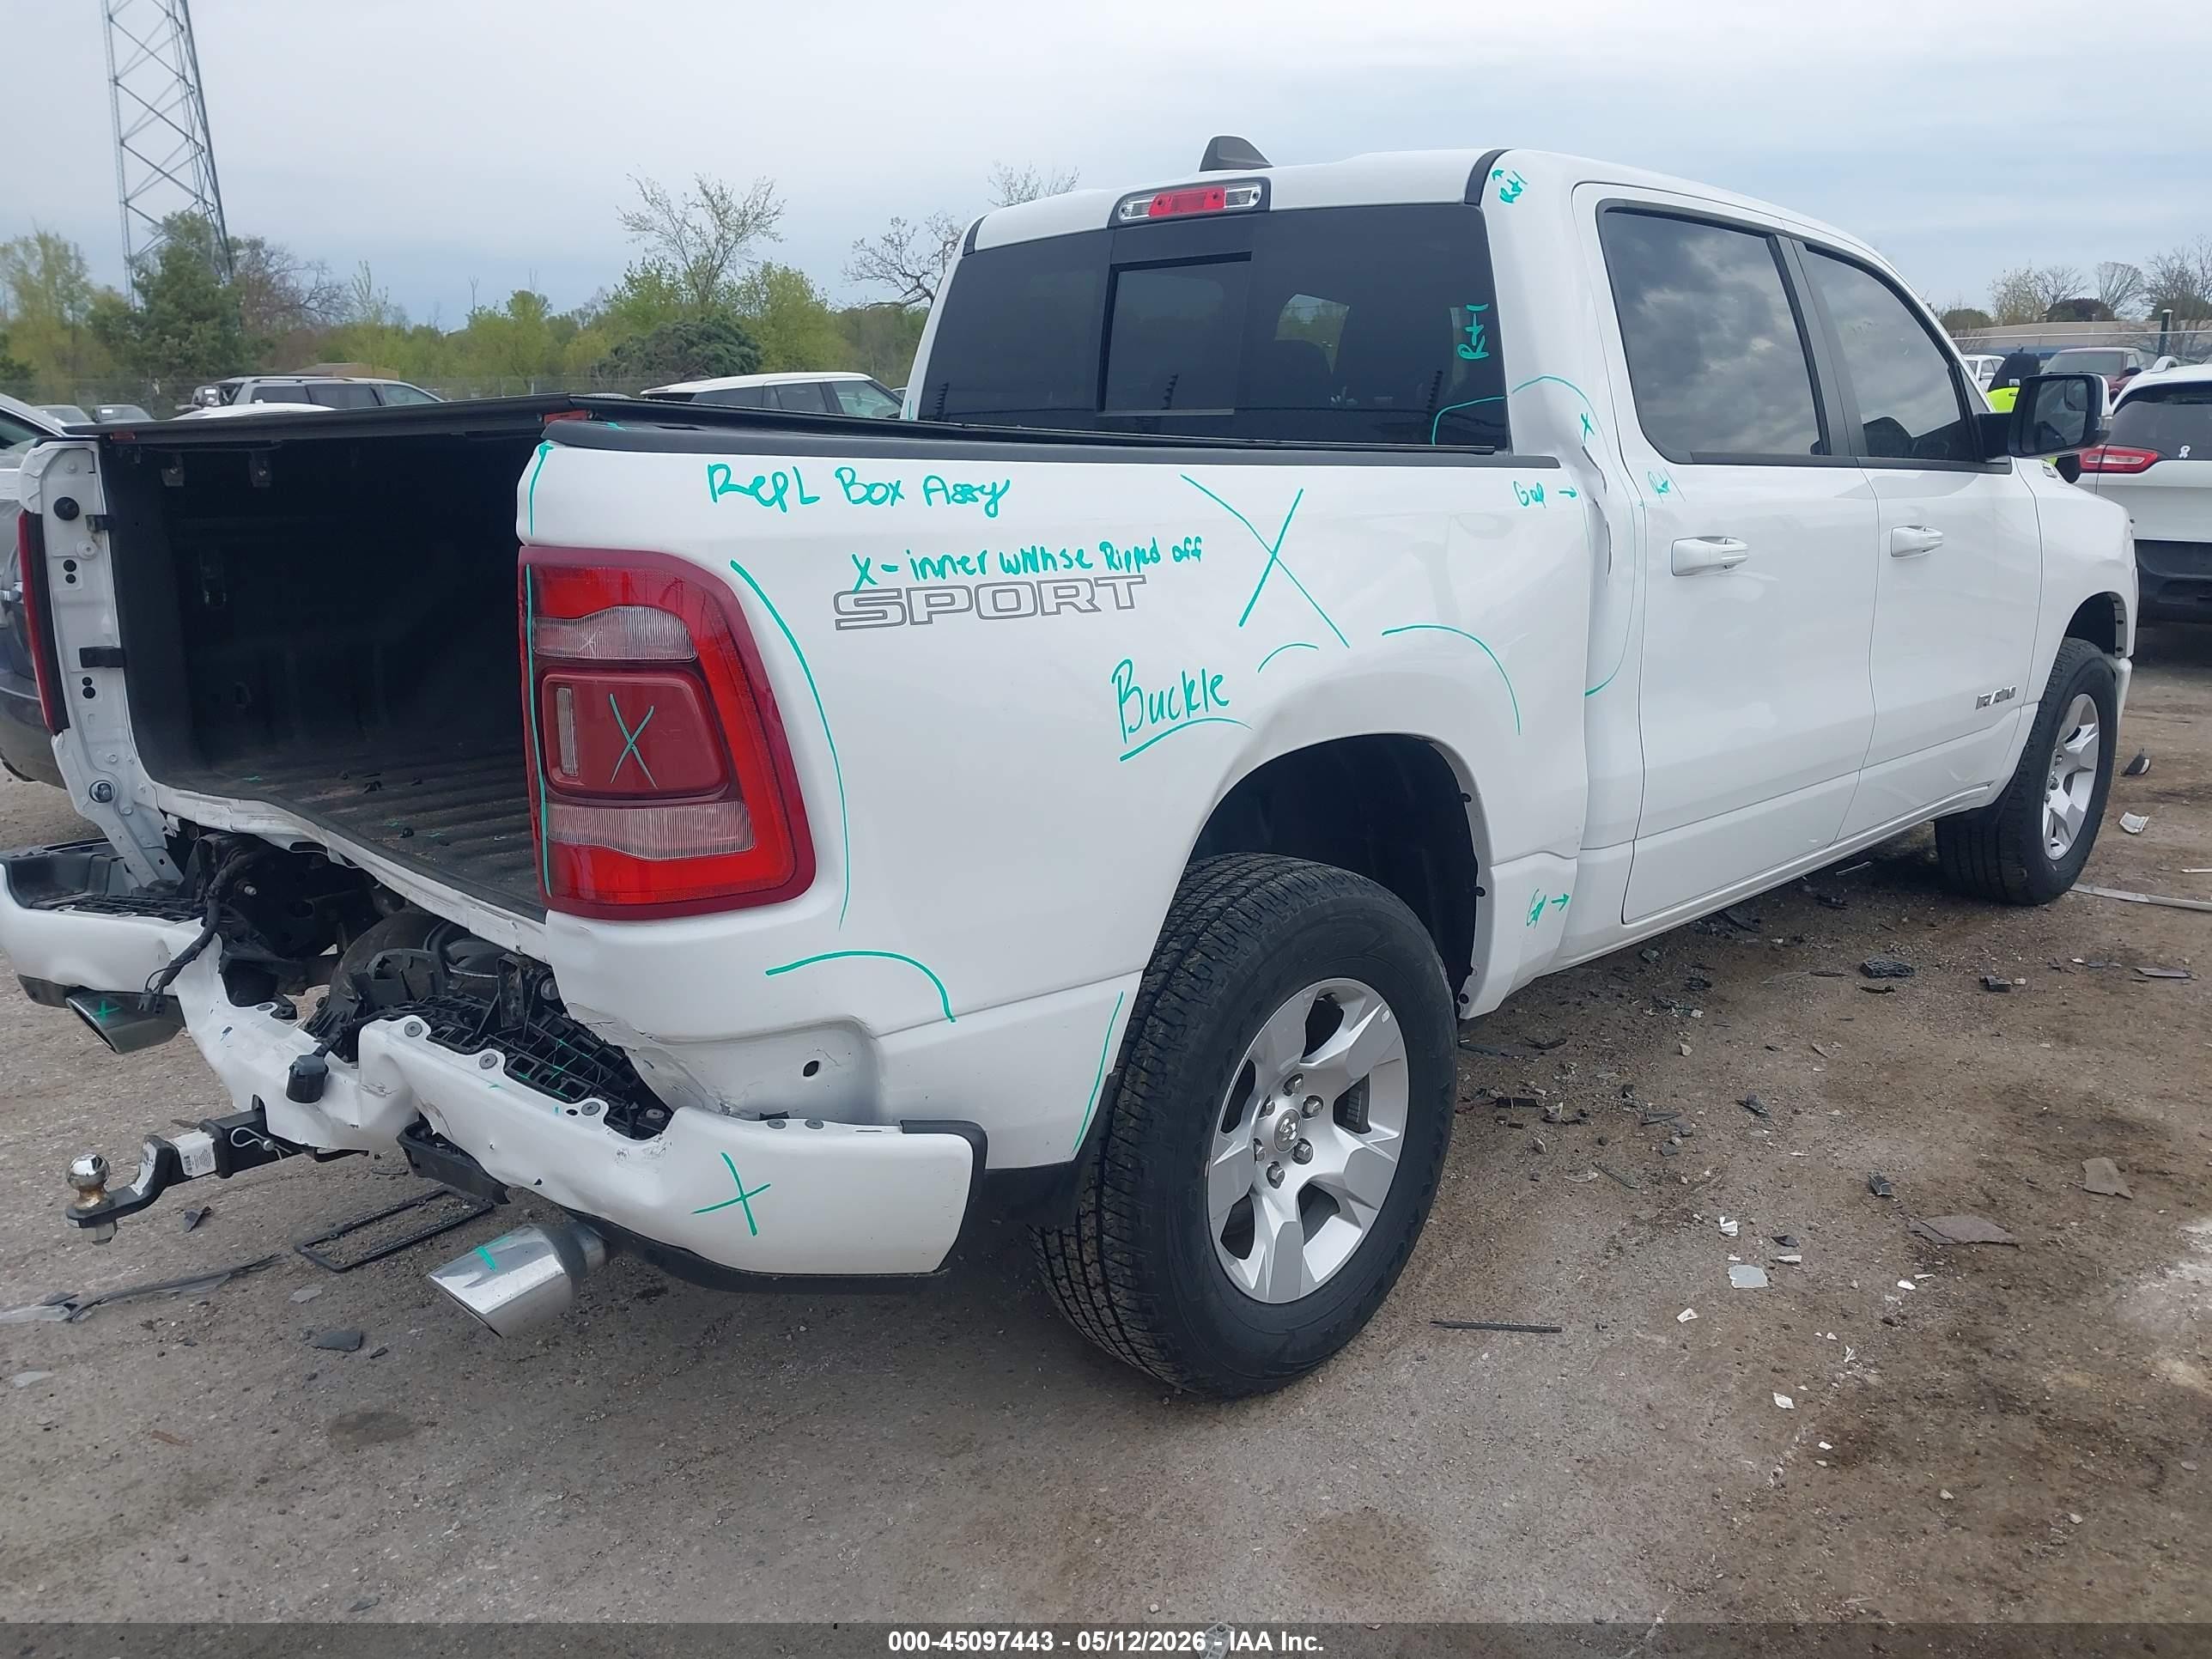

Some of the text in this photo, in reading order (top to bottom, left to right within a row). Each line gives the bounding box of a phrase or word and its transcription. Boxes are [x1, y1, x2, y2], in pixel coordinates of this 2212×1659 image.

[835, 466, 905, 507] Box
[905, 548, 988, 582] inner
[1171, 536, 1202, 563] off
[833, 574, 1147, 631] SPORT
[1111, 659, 1231, 744] Buckle
[1975, 685, 2017, 710] RAM
